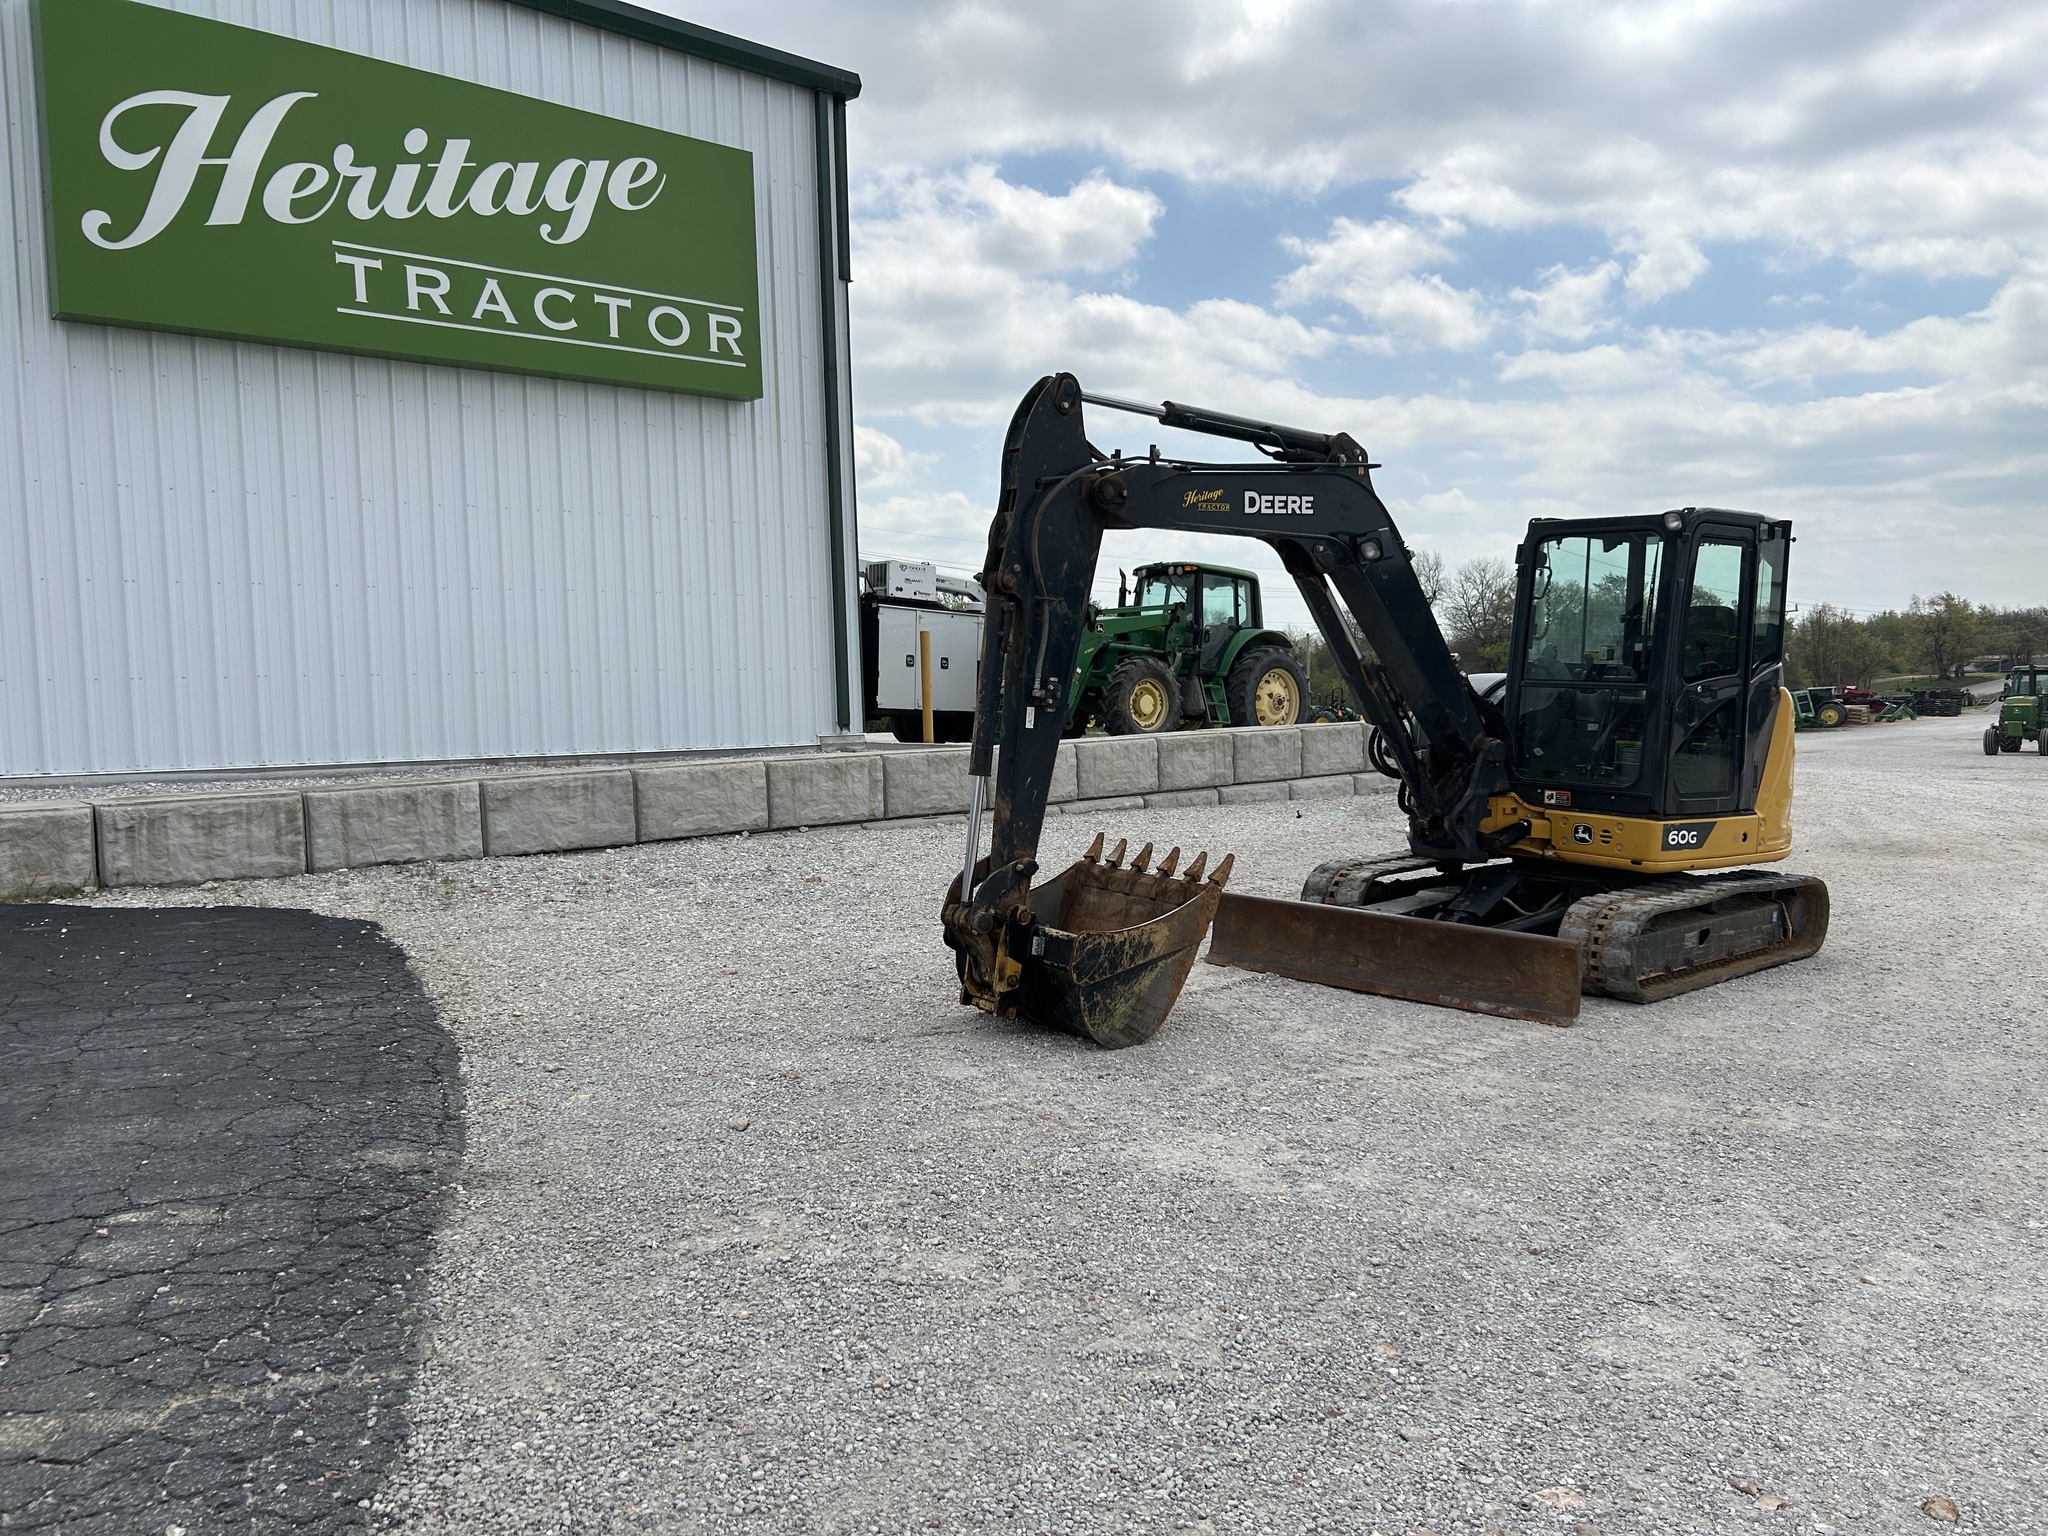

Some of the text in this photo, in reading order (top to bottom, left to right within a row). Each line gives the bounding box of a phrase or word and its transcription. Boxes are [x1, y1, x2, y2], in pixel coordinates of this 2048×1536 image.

[80, 89, 667, 251] Heritage
[335, 251, 745, 358] TRACTOR
[1182, 488, 1224, 508] Heritage
[1198, 503, 1230, 511] TRACTOR
[1244, 490, 1314, 515] DEERE
[1668, 830, 1698, 845] 60G
